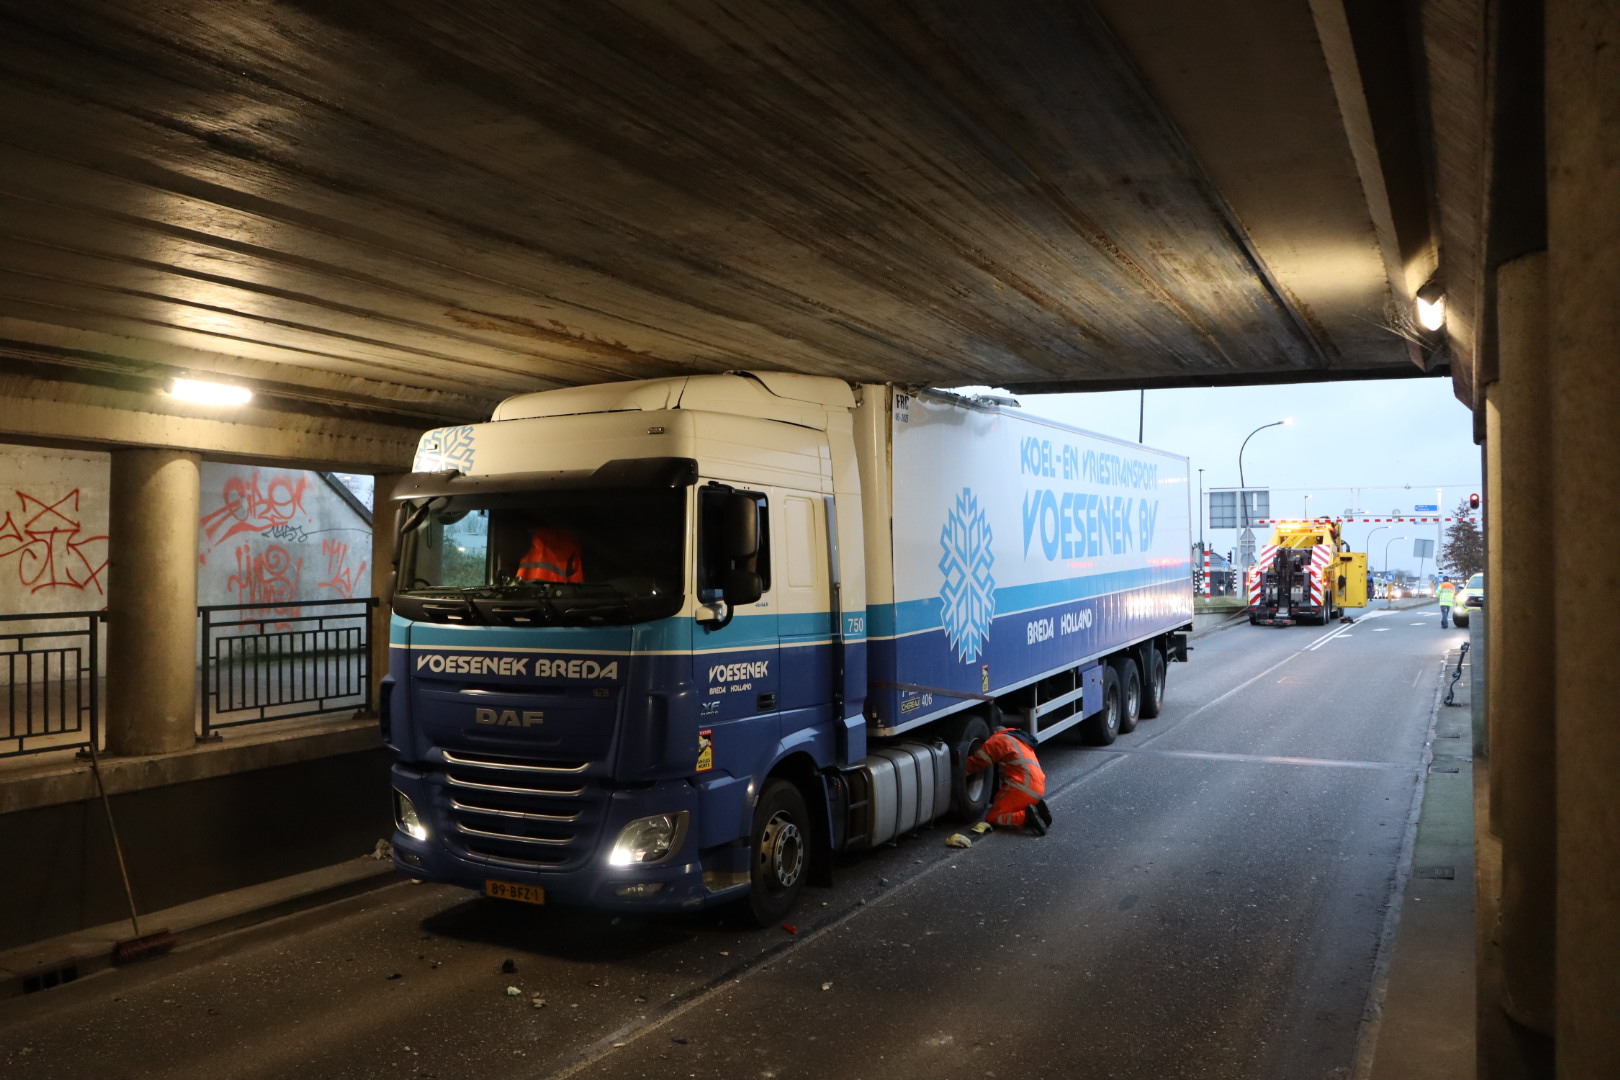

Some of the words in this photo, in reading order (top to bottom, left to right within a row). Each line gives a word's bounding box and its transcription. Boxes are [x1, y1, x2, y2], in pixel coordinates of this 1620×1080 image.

[896, 394, 909, 410] FRC
[1082, 449, 1158, 491] VRIESTRANSPORT
[1023, 488, 1133, 562] VOESENEK
[1139, 498, 1159, 552] BV
[848, 618, 864, 632] 750
[1027, 617, 1054, 645] BREDA
[1060, 608, 1092, 636] HOLLAND
[417, 655, 529, 676] VOESENEK
[535, 659, 618, 680] BREDA
[709, 661, 769, 683] VOESENEK
[709, 686, 727, 695] BREDA
[730, 683, 752, 692] HOLLAND
[702, 701, 720, 712] XF
[922, 694, 933, 707] 406
[476, 708, 543, 727] DAF
[491, 883, 539, 901] 89-BFZ-1
